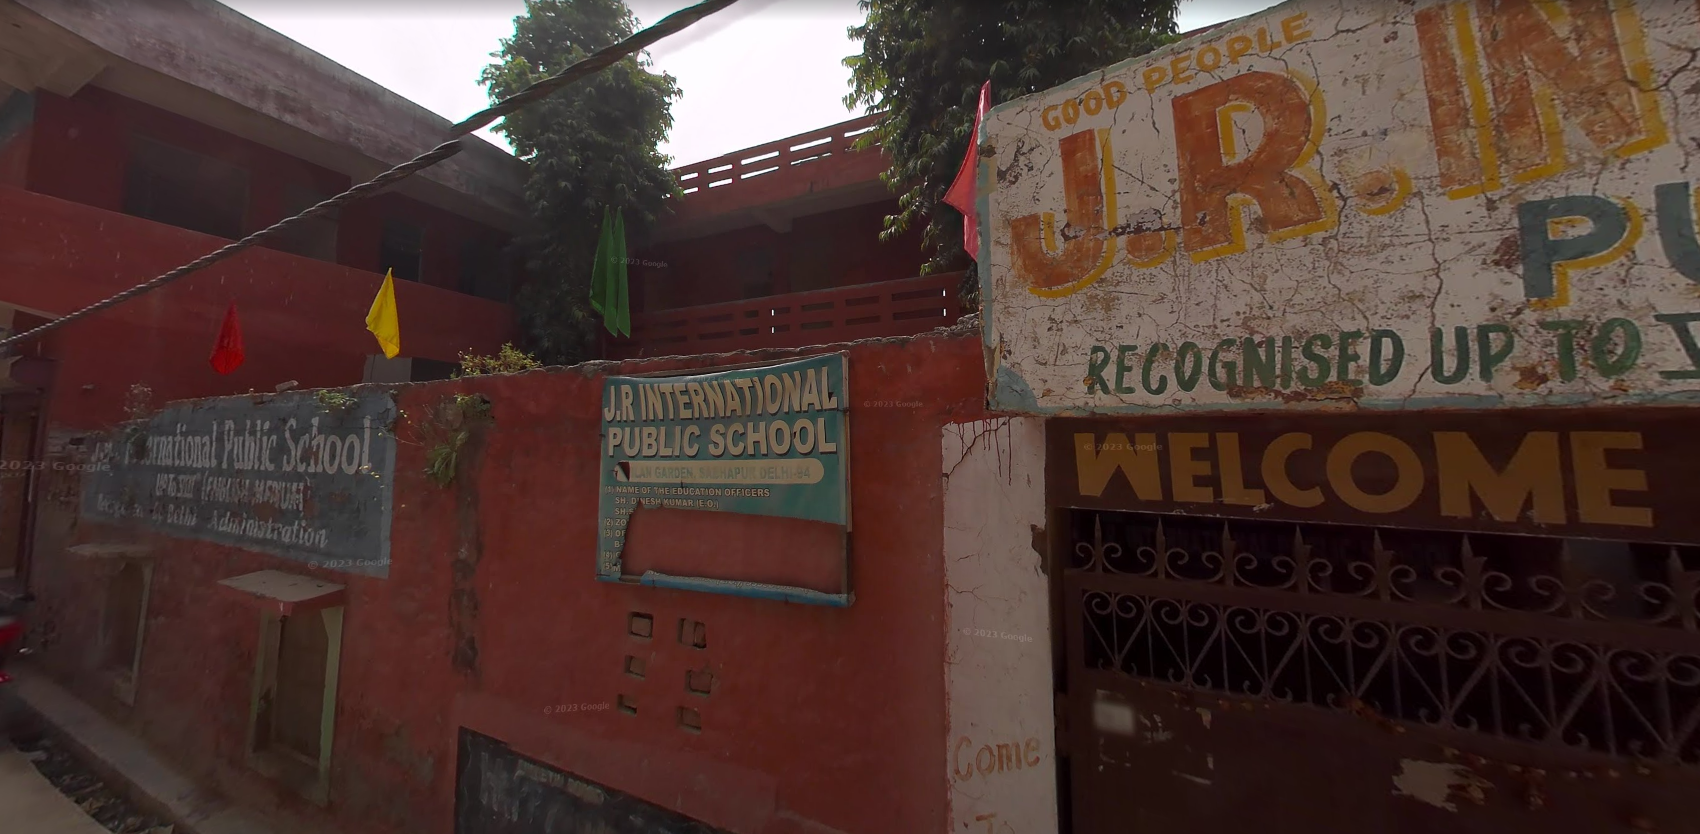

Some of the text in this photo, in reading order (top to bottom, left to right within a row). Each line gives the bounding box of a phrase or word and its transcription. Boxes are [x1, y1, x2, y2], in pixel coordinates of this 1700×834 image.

[1042, 12, 1312, 132] GOOD PEOPLE
[1086, 328, 1405, 396] RECOGNISED
[1431, 323, 1516, 386] UP
[1543, 317, 1643, 383] TO
[604, 366, 838, 423] J.R INTERNATIONAL
[221, 418, 278, 472] Public
[281, 415, 372, 475] School
[608, 417, 837, 457] PUBLIC SCHOOL
[616, 486, 640, 495] NAME
[641, 487, 652, 496] OF
[654, 487, 670, 496] THE
[672, 487, 721, 497] EDUCATION
[724, 488, 770, 498] OFFICERS
[663, 499, 694, 508] KUMAR
[1074, 432, 1654, 527] WELCOME
[207, 510, 329, 549] Administration
[953, 735, 1041, 782] Come
